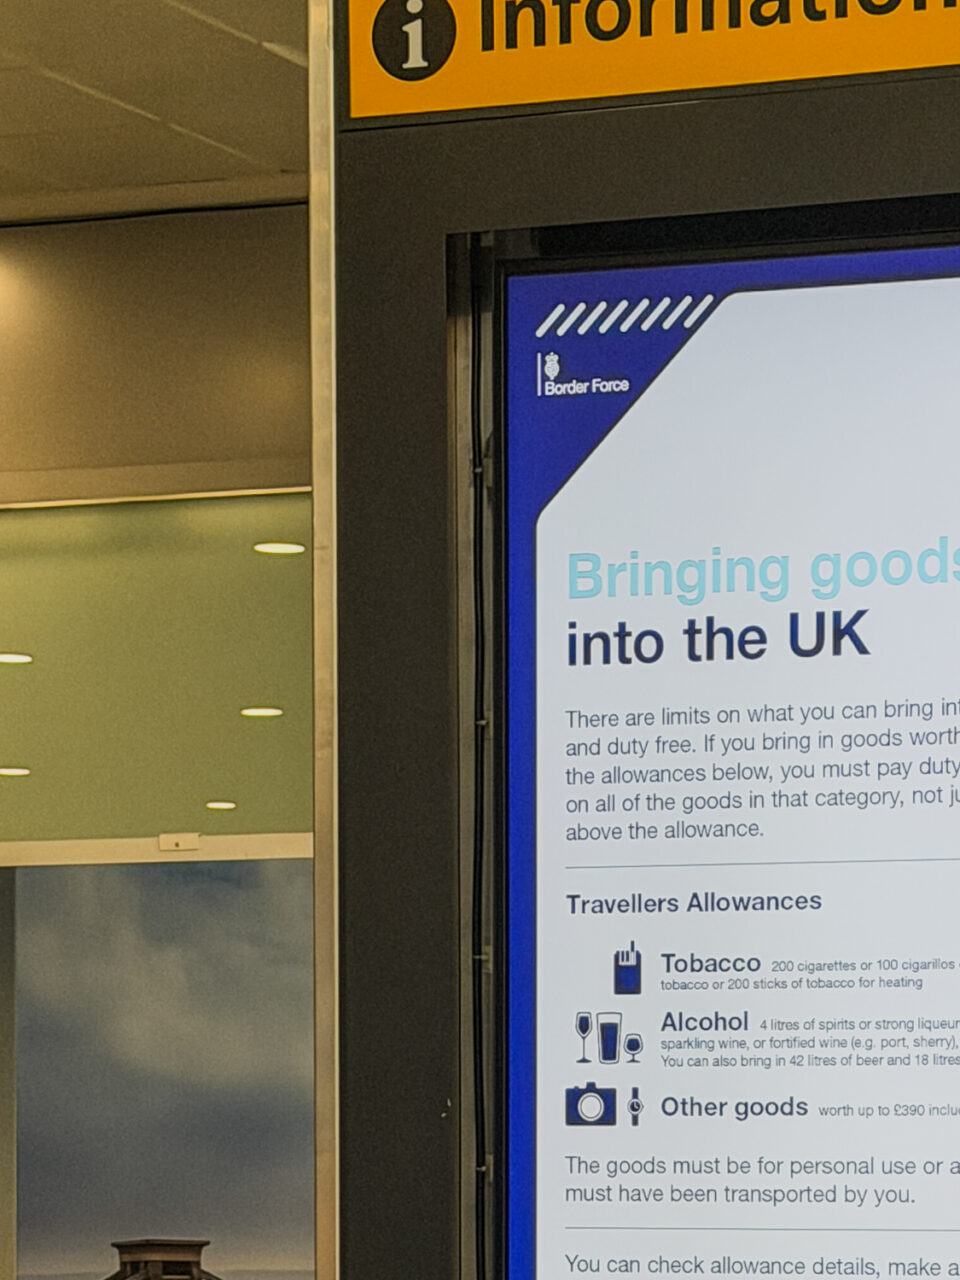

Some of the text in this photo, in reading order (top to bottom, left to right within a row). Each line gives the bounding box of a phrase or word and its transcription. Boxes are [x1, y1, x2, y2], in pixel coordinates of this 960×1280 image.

[545, 378, 630, 396] Border Force
[569, 546, 789, 606] Bringing
[568, 609, 871, 667] into the UK
[565, 709, 619, 729] There
[625, 712, 655, 727] are
[662, 705, 710, 726] limits
[717, 709, 740, 724] on
[747, 704, 794, 723] what
[800, 705, 834, 726] you
[842, 704, 877, 720] can
[885, 699, 933, 722] bring
[566, 819, 764, 841] above the allowance.
[566, 891, 822, 915] Travellers Allowances
[661, 952, 761, 974] Tobacco
[771, 959, 794, 973] 200
[797, 960, 856, 975] cigarettes
[860, 961, 873, 971] or
[877, 959, 898, 971] 100
[902, 958, 955, 974] cigarillos
[661, 975, 923, 991] tobacco or 200 sticks of tobacco for heating
[661, 1010, 748, 1033] Alcohol
[760, 1019, 767, 1031] 4
[771, 1017, 800, 1032] litres
[803, 1017, 815, 1030] of
[818, 1017, 855, 1033] spirits
[859, 1020, 872, 1031] or
[875, 1018, 914, 1033] strong
[661, 1036, 715, 1053] sparkling
[718, 1036, 749, 1051] wine,
[753, 1039, 766, 1049] or
[769, 1035, 815, 1049] fortified
[819, 1035, 847, 1049] wine
[851, 1035, 876, 1051] (e.g.
[881, 1037, 909, 1051] port,
[913, 1034, 958, 1051] sherry),
[661, 1095, 728, 1117] Other
[735, 1096, 808, 1122] goods
[819, 1104, 854, 1117] worth
[858, 1107, 874, 1119] up
[878, 1105, 890, 1117] to
[894, 1103, 925, 1117] £390
[566, 1183, 915, 1208] must have been transported by you.
[565, 1254, 600, 1273] You
[607, 1259, 640, 1273] can
[648, 1254, 704, 1274] check
[711, 1256, 805, 1275] allowance
[813, 1256, 880, 1280] details,
[889, 1257, 941, 1276] make
[948, 1262, 960, 1277] a
